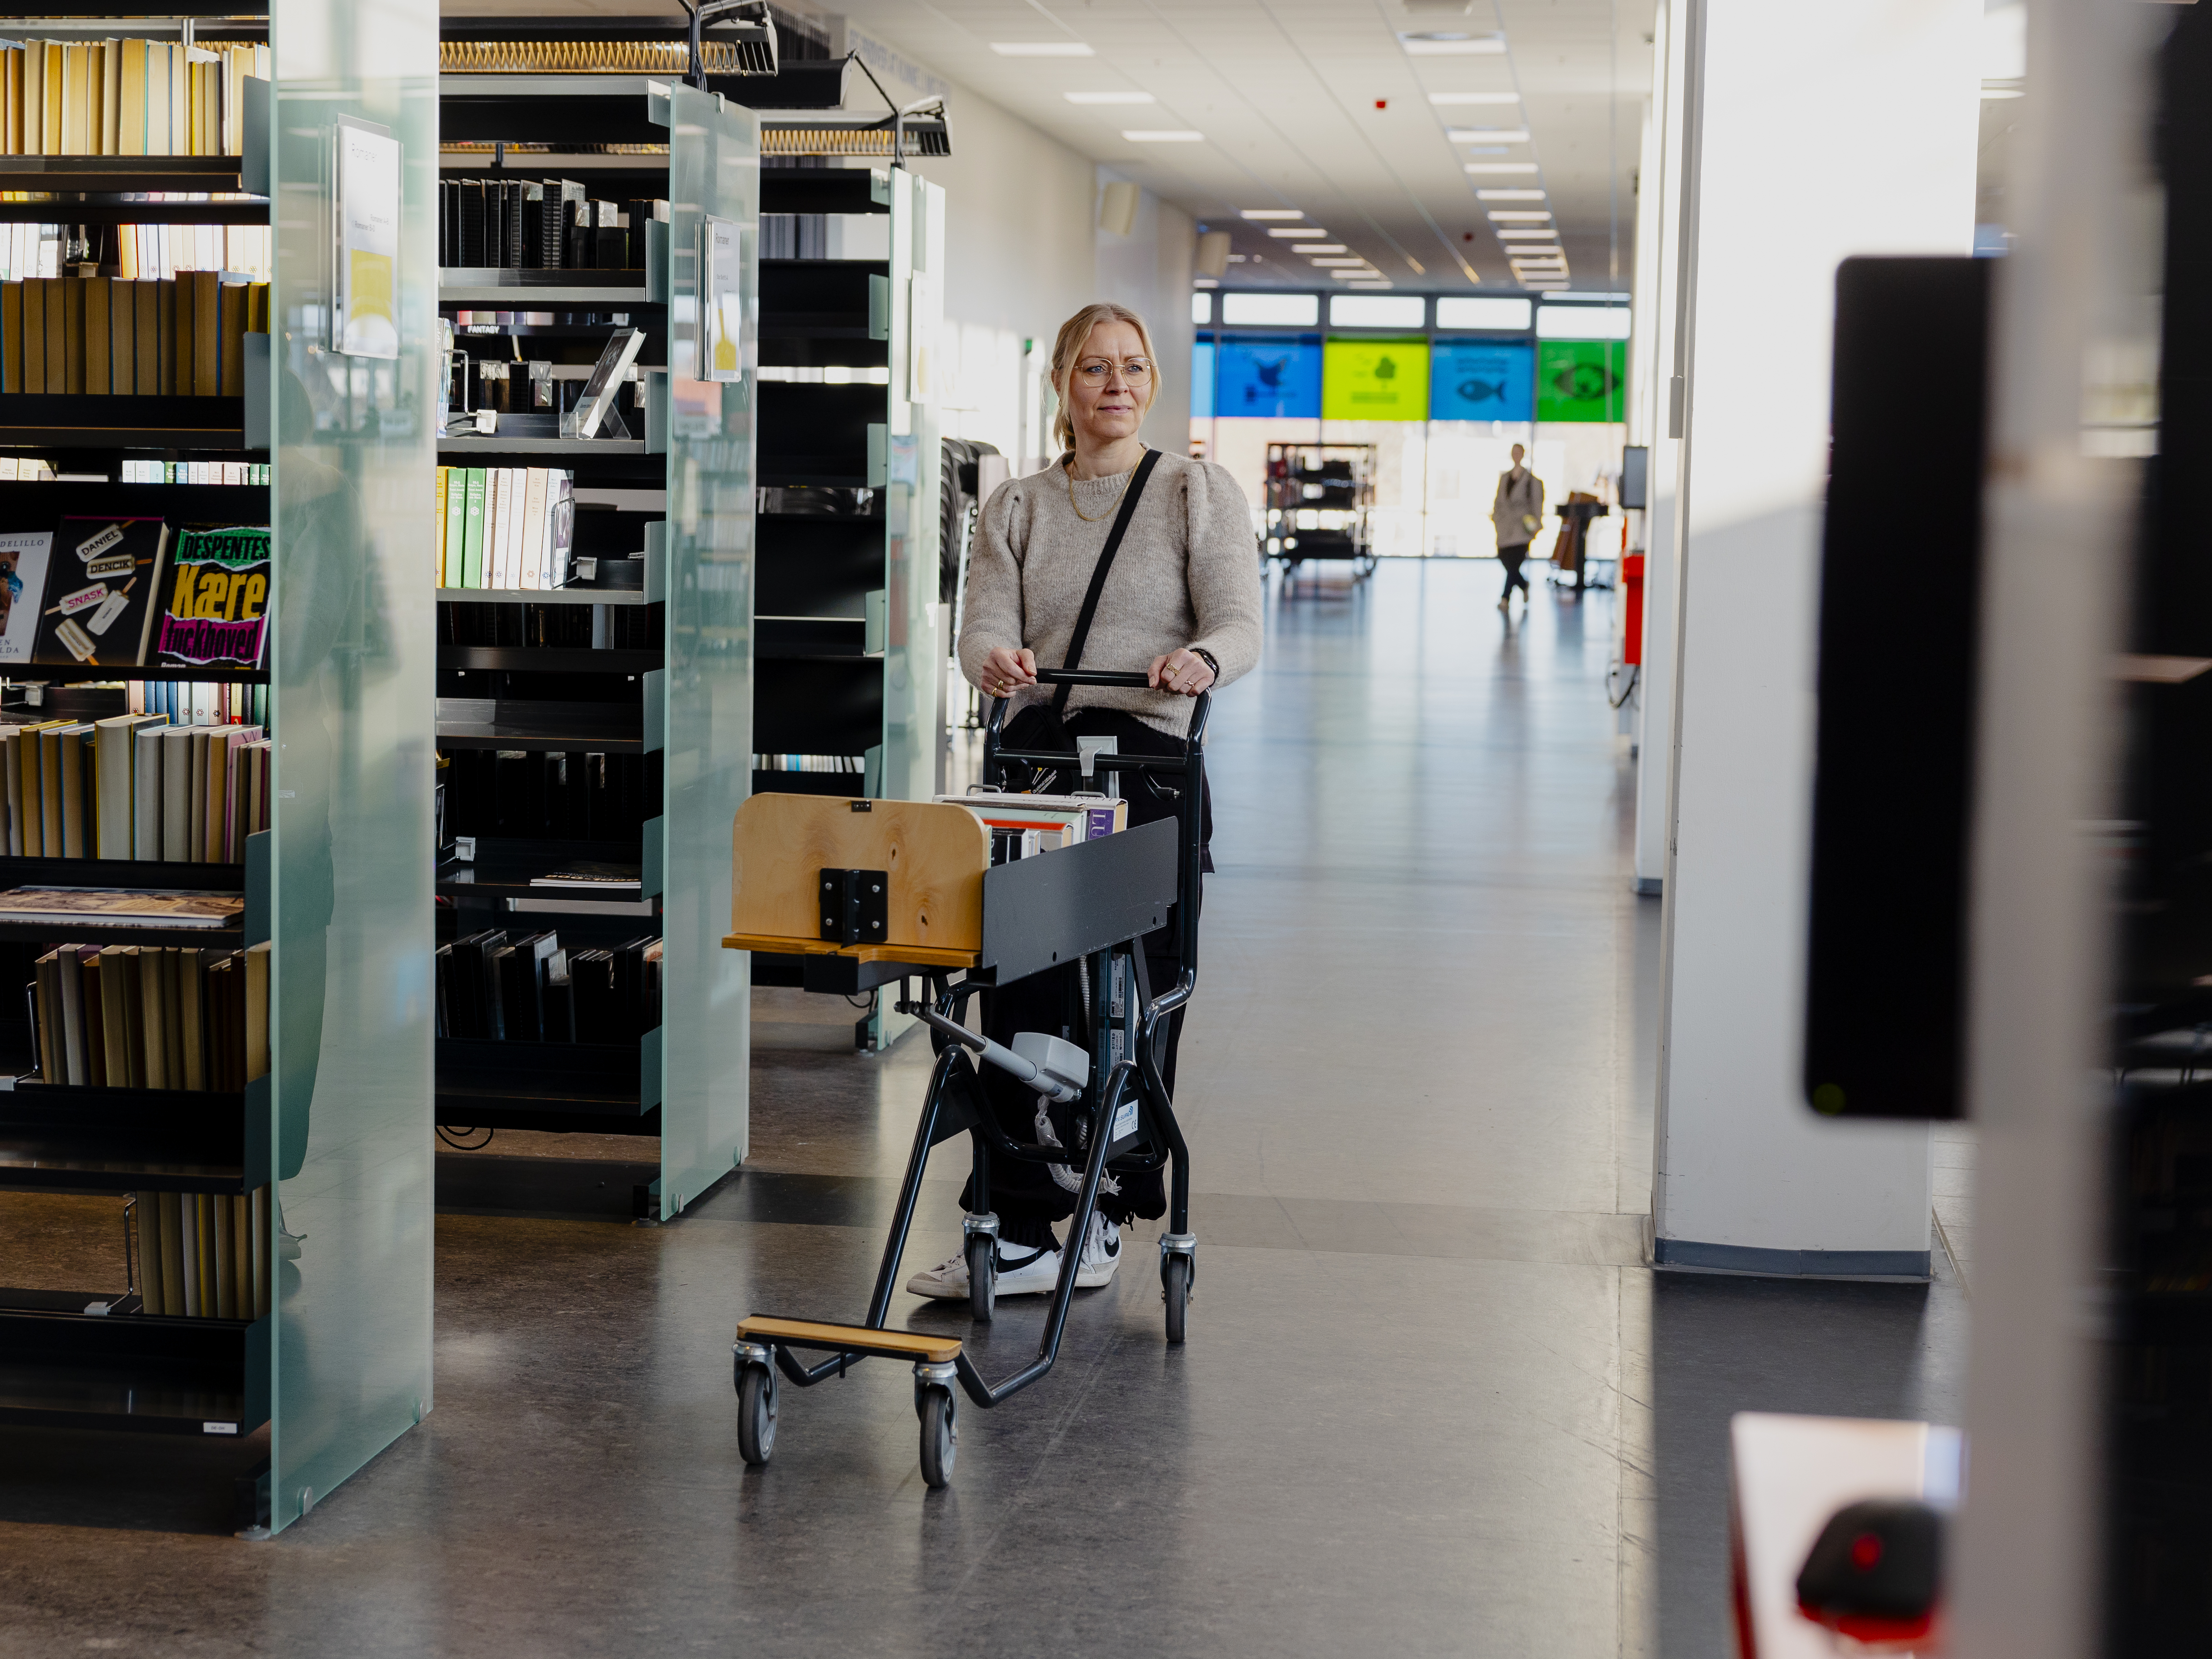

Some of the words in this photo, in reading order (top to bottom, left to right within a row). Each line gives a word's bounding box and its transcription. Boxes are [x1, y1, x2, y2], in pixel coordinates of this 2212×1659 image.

[352, 143, 377, 162] Romaner
[715, 233, 729, 245] Romaner
[468, 325, 500, 334] FANTASY
[81, 530, 118, 556] DANIEL
[182, 535, 271, 560] DESPENTES
[90, 559, 131, 573] DENCIK
[68, 588, 104, 608] SNASK
[171, 563, 266, 621] Kære
